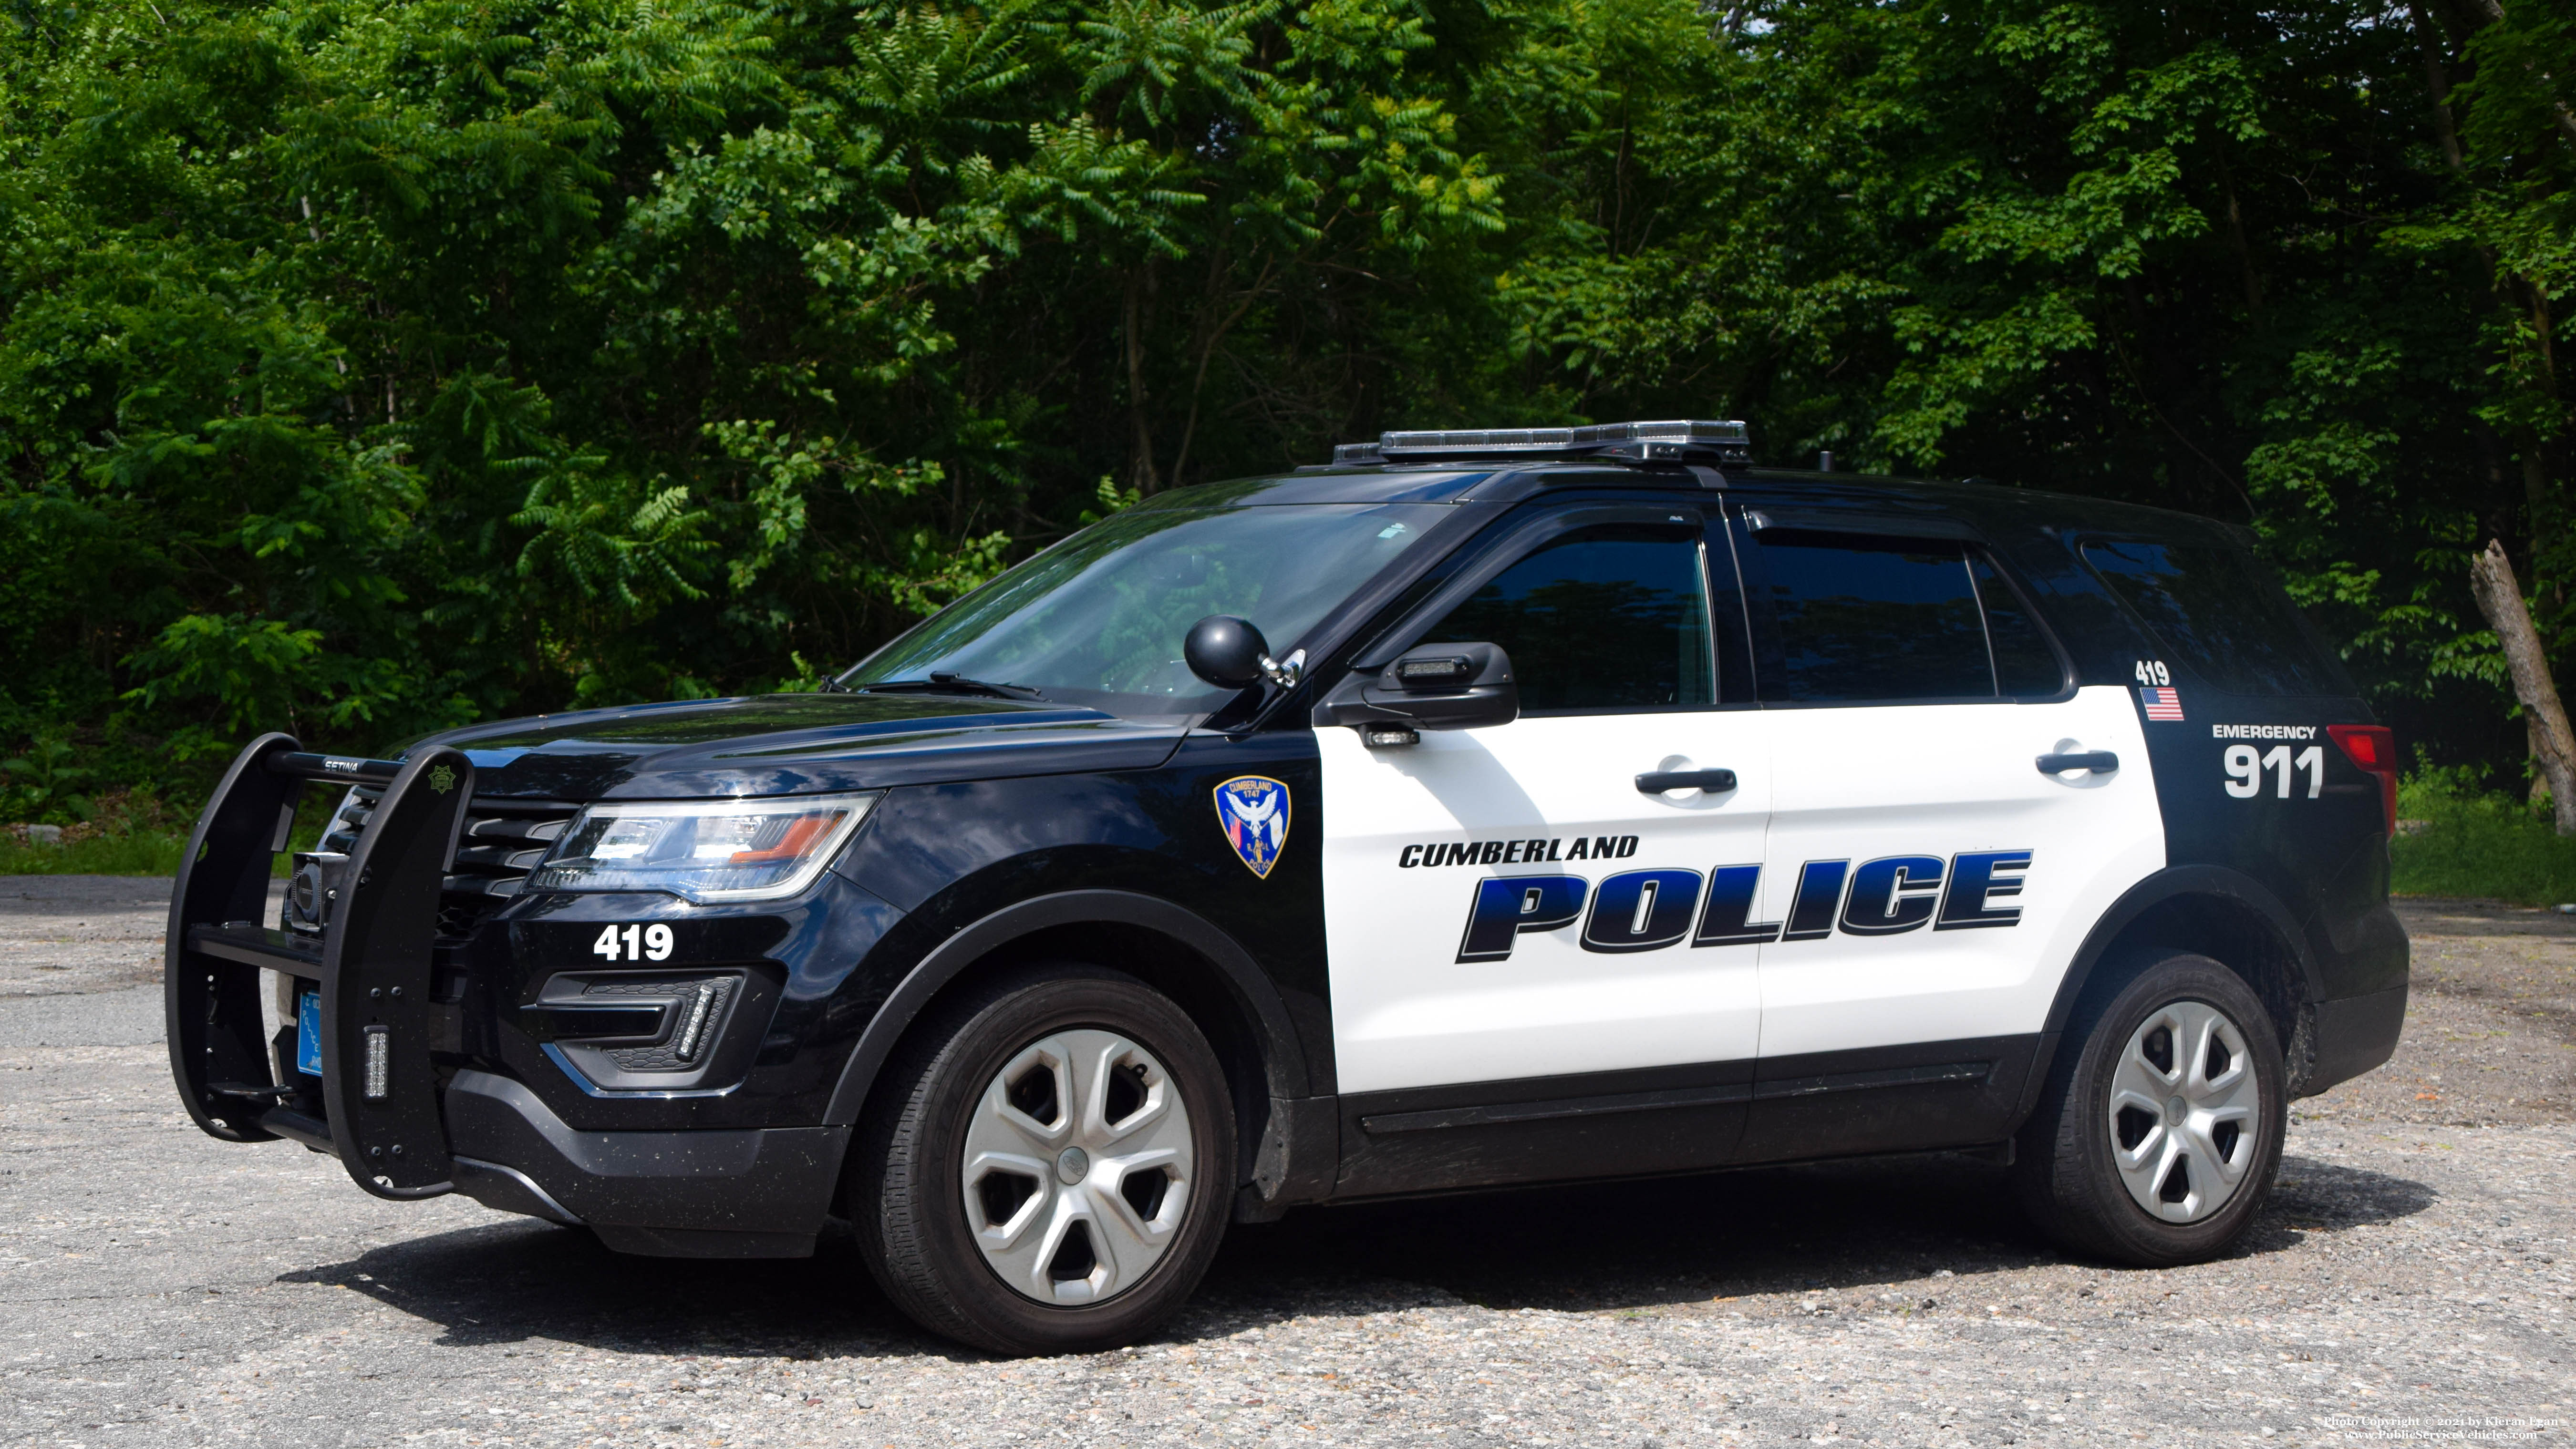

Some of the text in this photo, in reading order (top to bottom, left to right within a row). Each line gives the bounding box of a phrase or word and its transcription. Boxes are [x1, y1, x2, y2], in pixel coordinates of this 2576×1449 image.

[2135, 660, 2170, 686] 419
[2212, 724, 2317, 740] EMERGENCY
[325, 761, 358, 773] SETINA
[2224, 744, 2323, 799] 911
[1229, 780, 1272, 793] CUMBERLAND
[1249, 858, 1272, 872] POLICE
[1398, 835, 1640, 868] CUMBERLAND
[1454, 848, 2034, 964] POLICE
[594, 924, 673, 961] 419
[302, 1010, 319, 1052] POLICE
